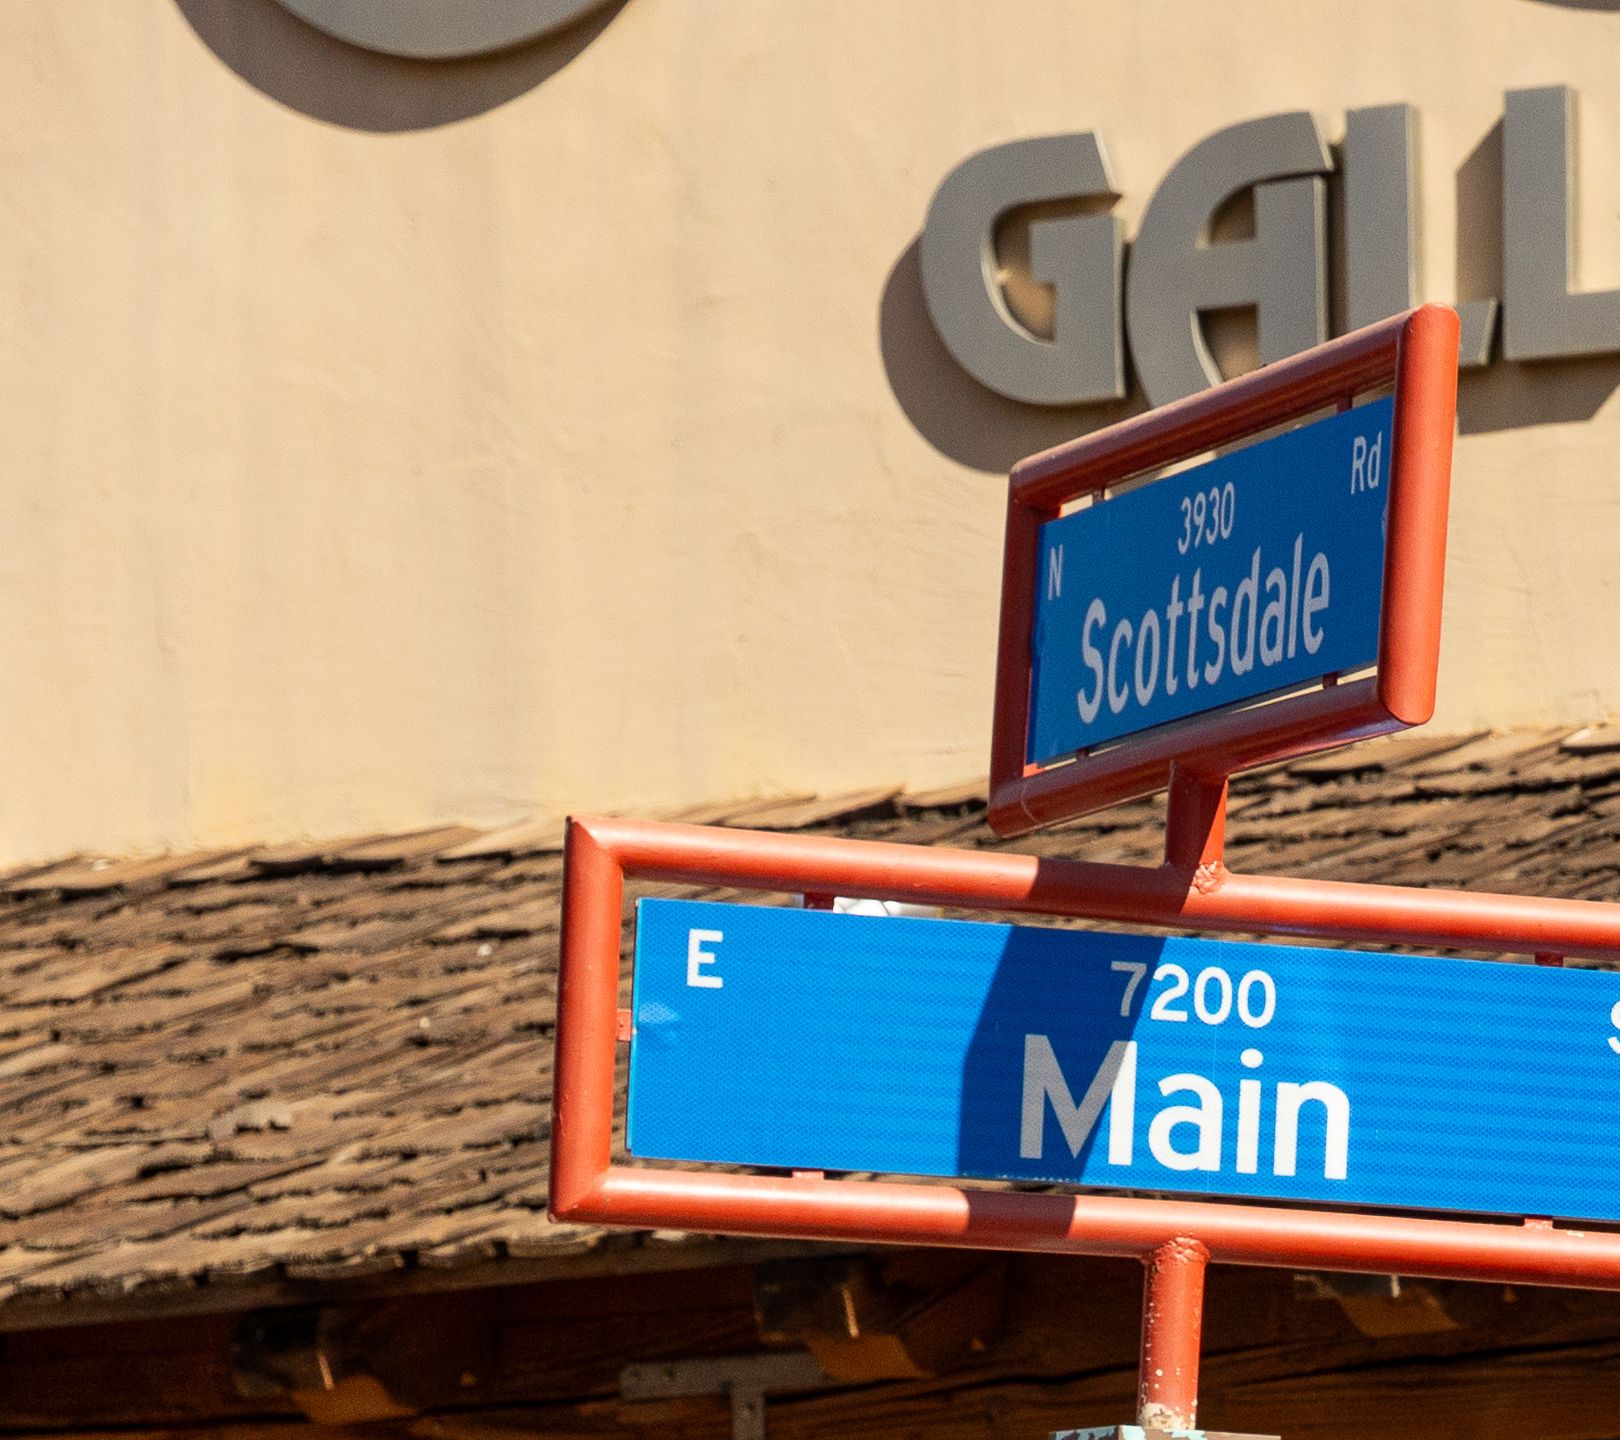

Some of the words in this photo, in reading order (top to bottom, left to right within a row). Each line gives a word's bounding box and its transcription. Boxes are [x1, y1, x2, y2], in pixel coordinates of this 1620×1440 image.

[1177, 482, 1235, 556] 3930
[1350, 431, 1383, 495] Rd
[1047, 544, 1064, 600] N
[1077, 532, 1332, 724] Scottsdale
[685, 928, 725, 989] E
[1110, 960, 1278, 1028] 7200
[1018, 1033, 1350, 1181] Main
